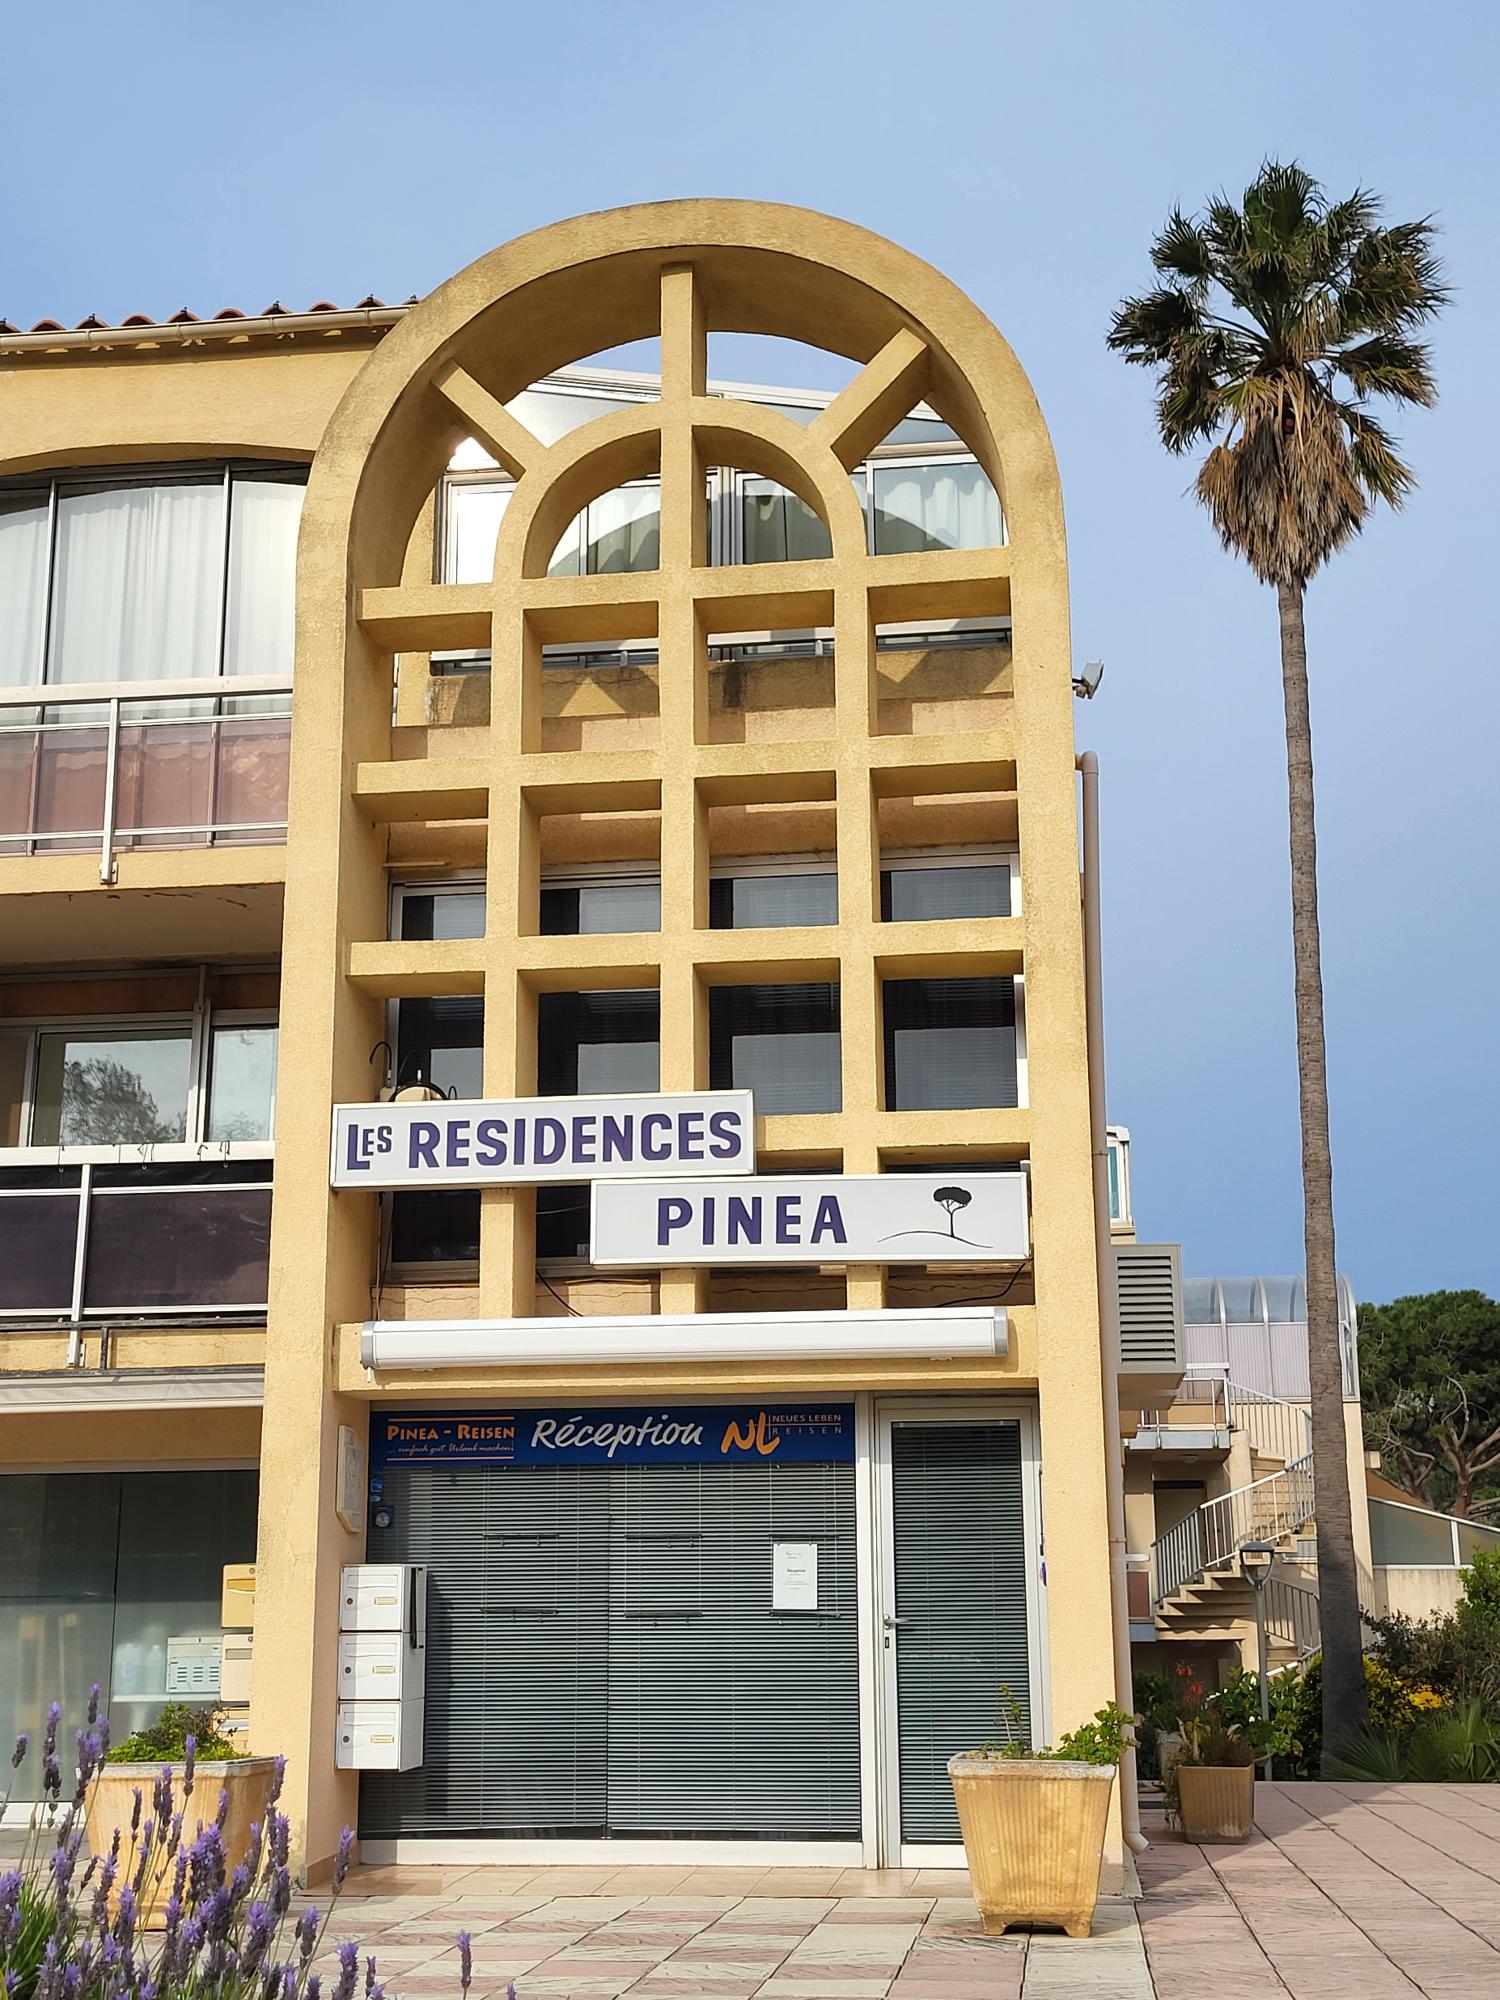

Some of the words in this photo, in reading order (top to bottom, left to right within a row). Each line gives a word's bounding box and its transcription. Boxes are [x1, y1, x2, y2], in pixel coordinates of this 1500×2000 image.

[408, 1110, 743, 1169] RESIDENCES
[656, 1194, 849, 1246] PINEA
[457, 1424, 515, 1440] REISEN
[772, 1414, 806, 1423] NEUES
[808, 1414, 841, 1423] LEBEN
[772, 1426, 842, 1435] REISEN
[530, 1413, 703, 1458] Réception
